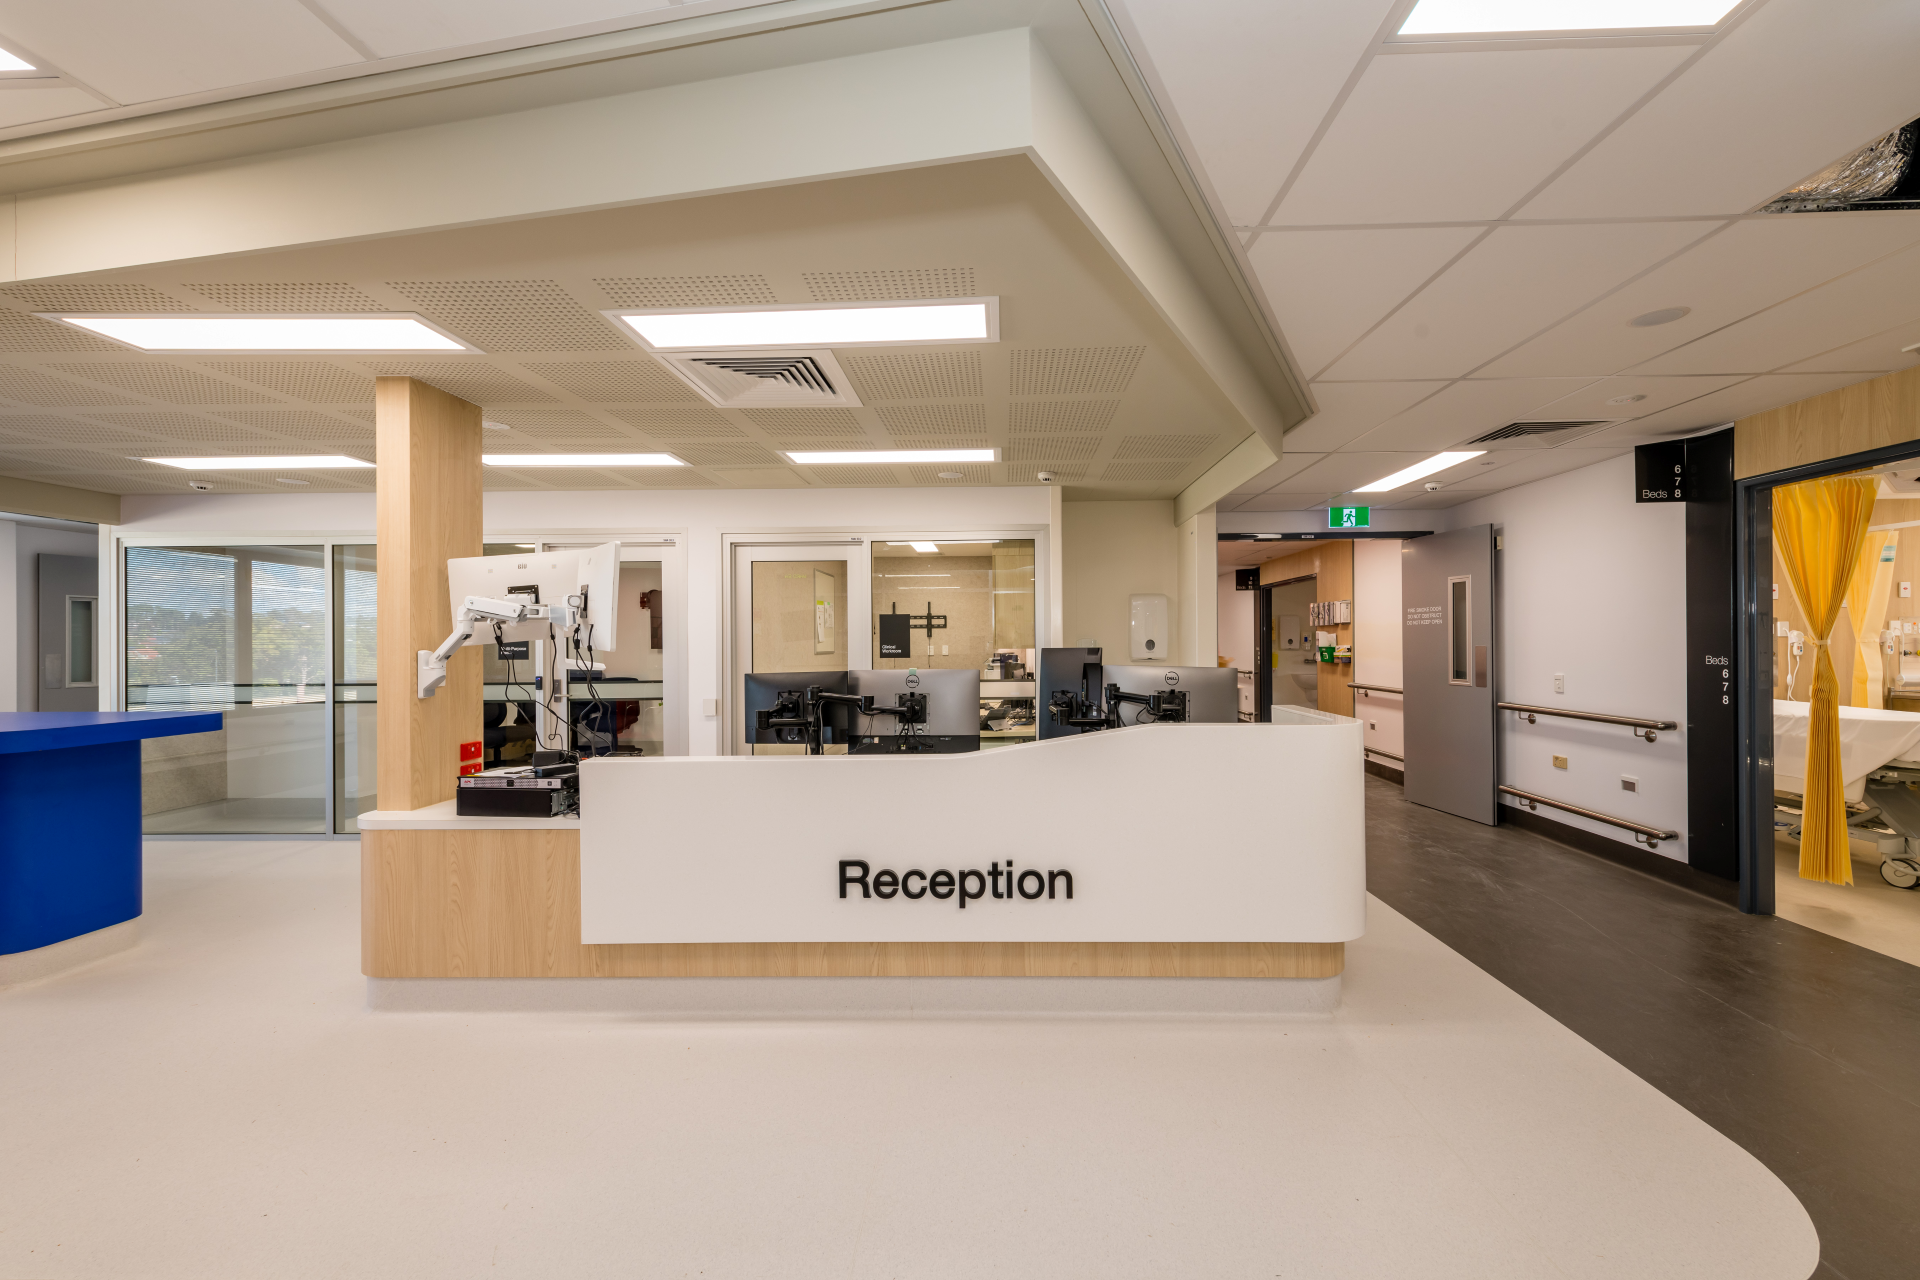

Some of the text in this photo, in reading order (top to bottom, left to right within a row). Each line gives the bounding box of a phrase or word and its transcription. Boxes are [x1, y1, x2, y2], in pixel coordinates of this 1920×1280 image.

[1674, 464, 1681, 474] 6
[1674, 477, 1681, 486] 7
[1642, 489, 1681, 498] Beds 8
[1705, 655, 1728, 665] Beds
[1722, 669, 1729, 678] 6
[1722, 682, 1729, 691] 7
[1722, 695, 1729, 704] 8
[838, 860, 1074, 908] Reception
